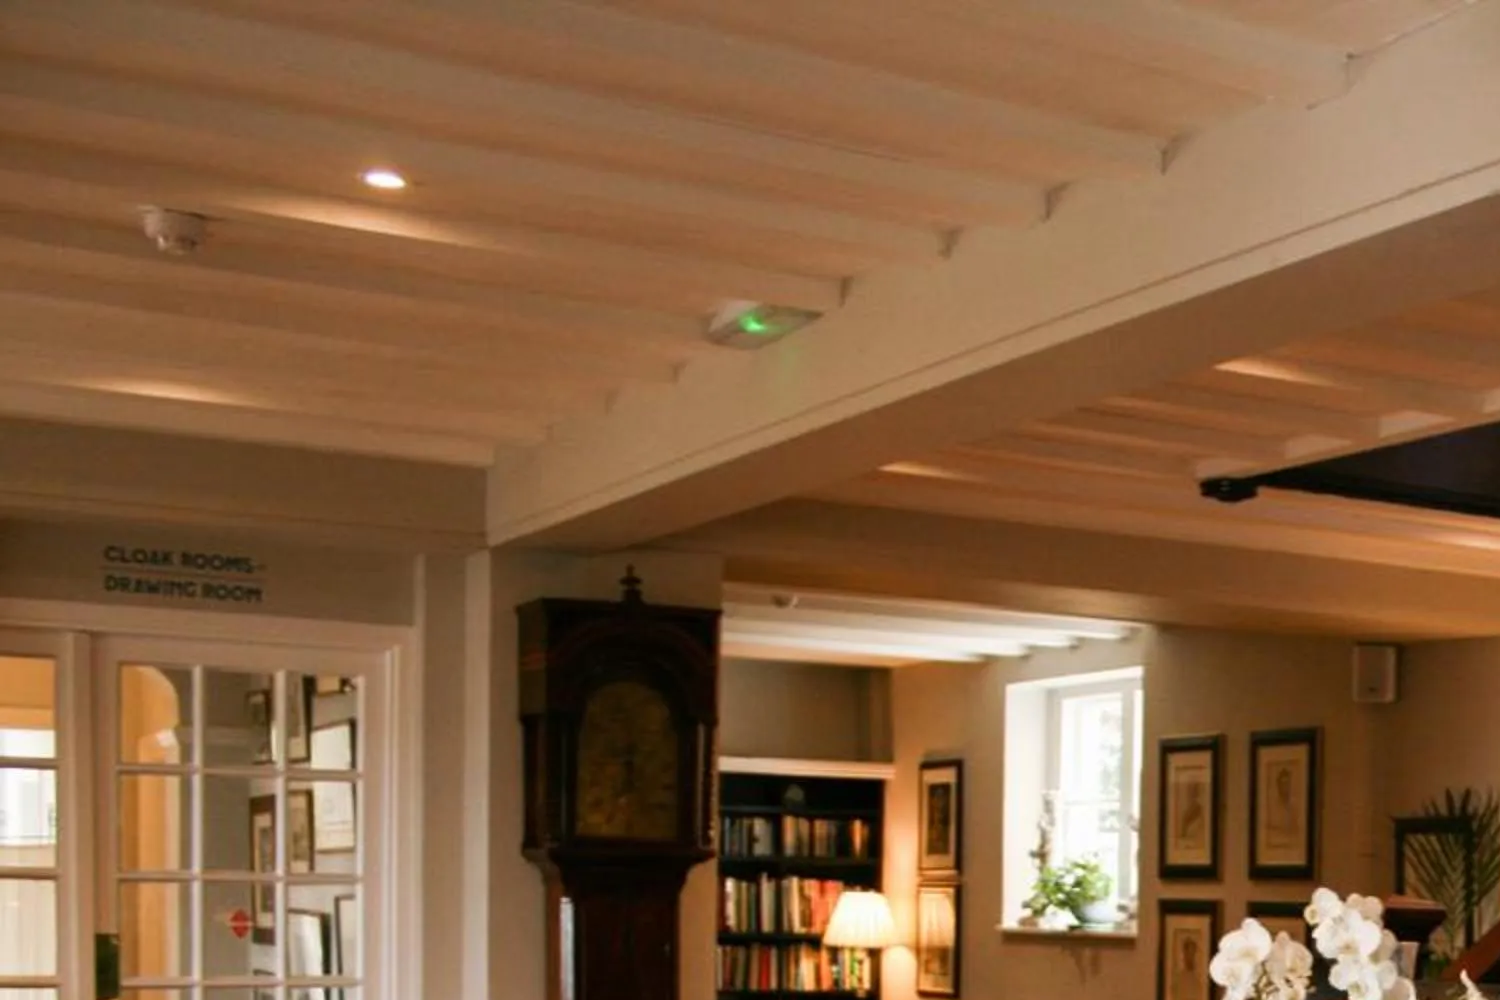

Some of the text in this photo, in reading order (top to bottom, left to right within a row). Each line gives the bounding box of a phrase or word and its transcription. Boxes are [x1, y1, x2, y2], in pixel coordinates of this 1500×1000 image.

[104, 545, 173, 566] CLOAK
[104, 575, 263, 602] DRAWING ROOM
